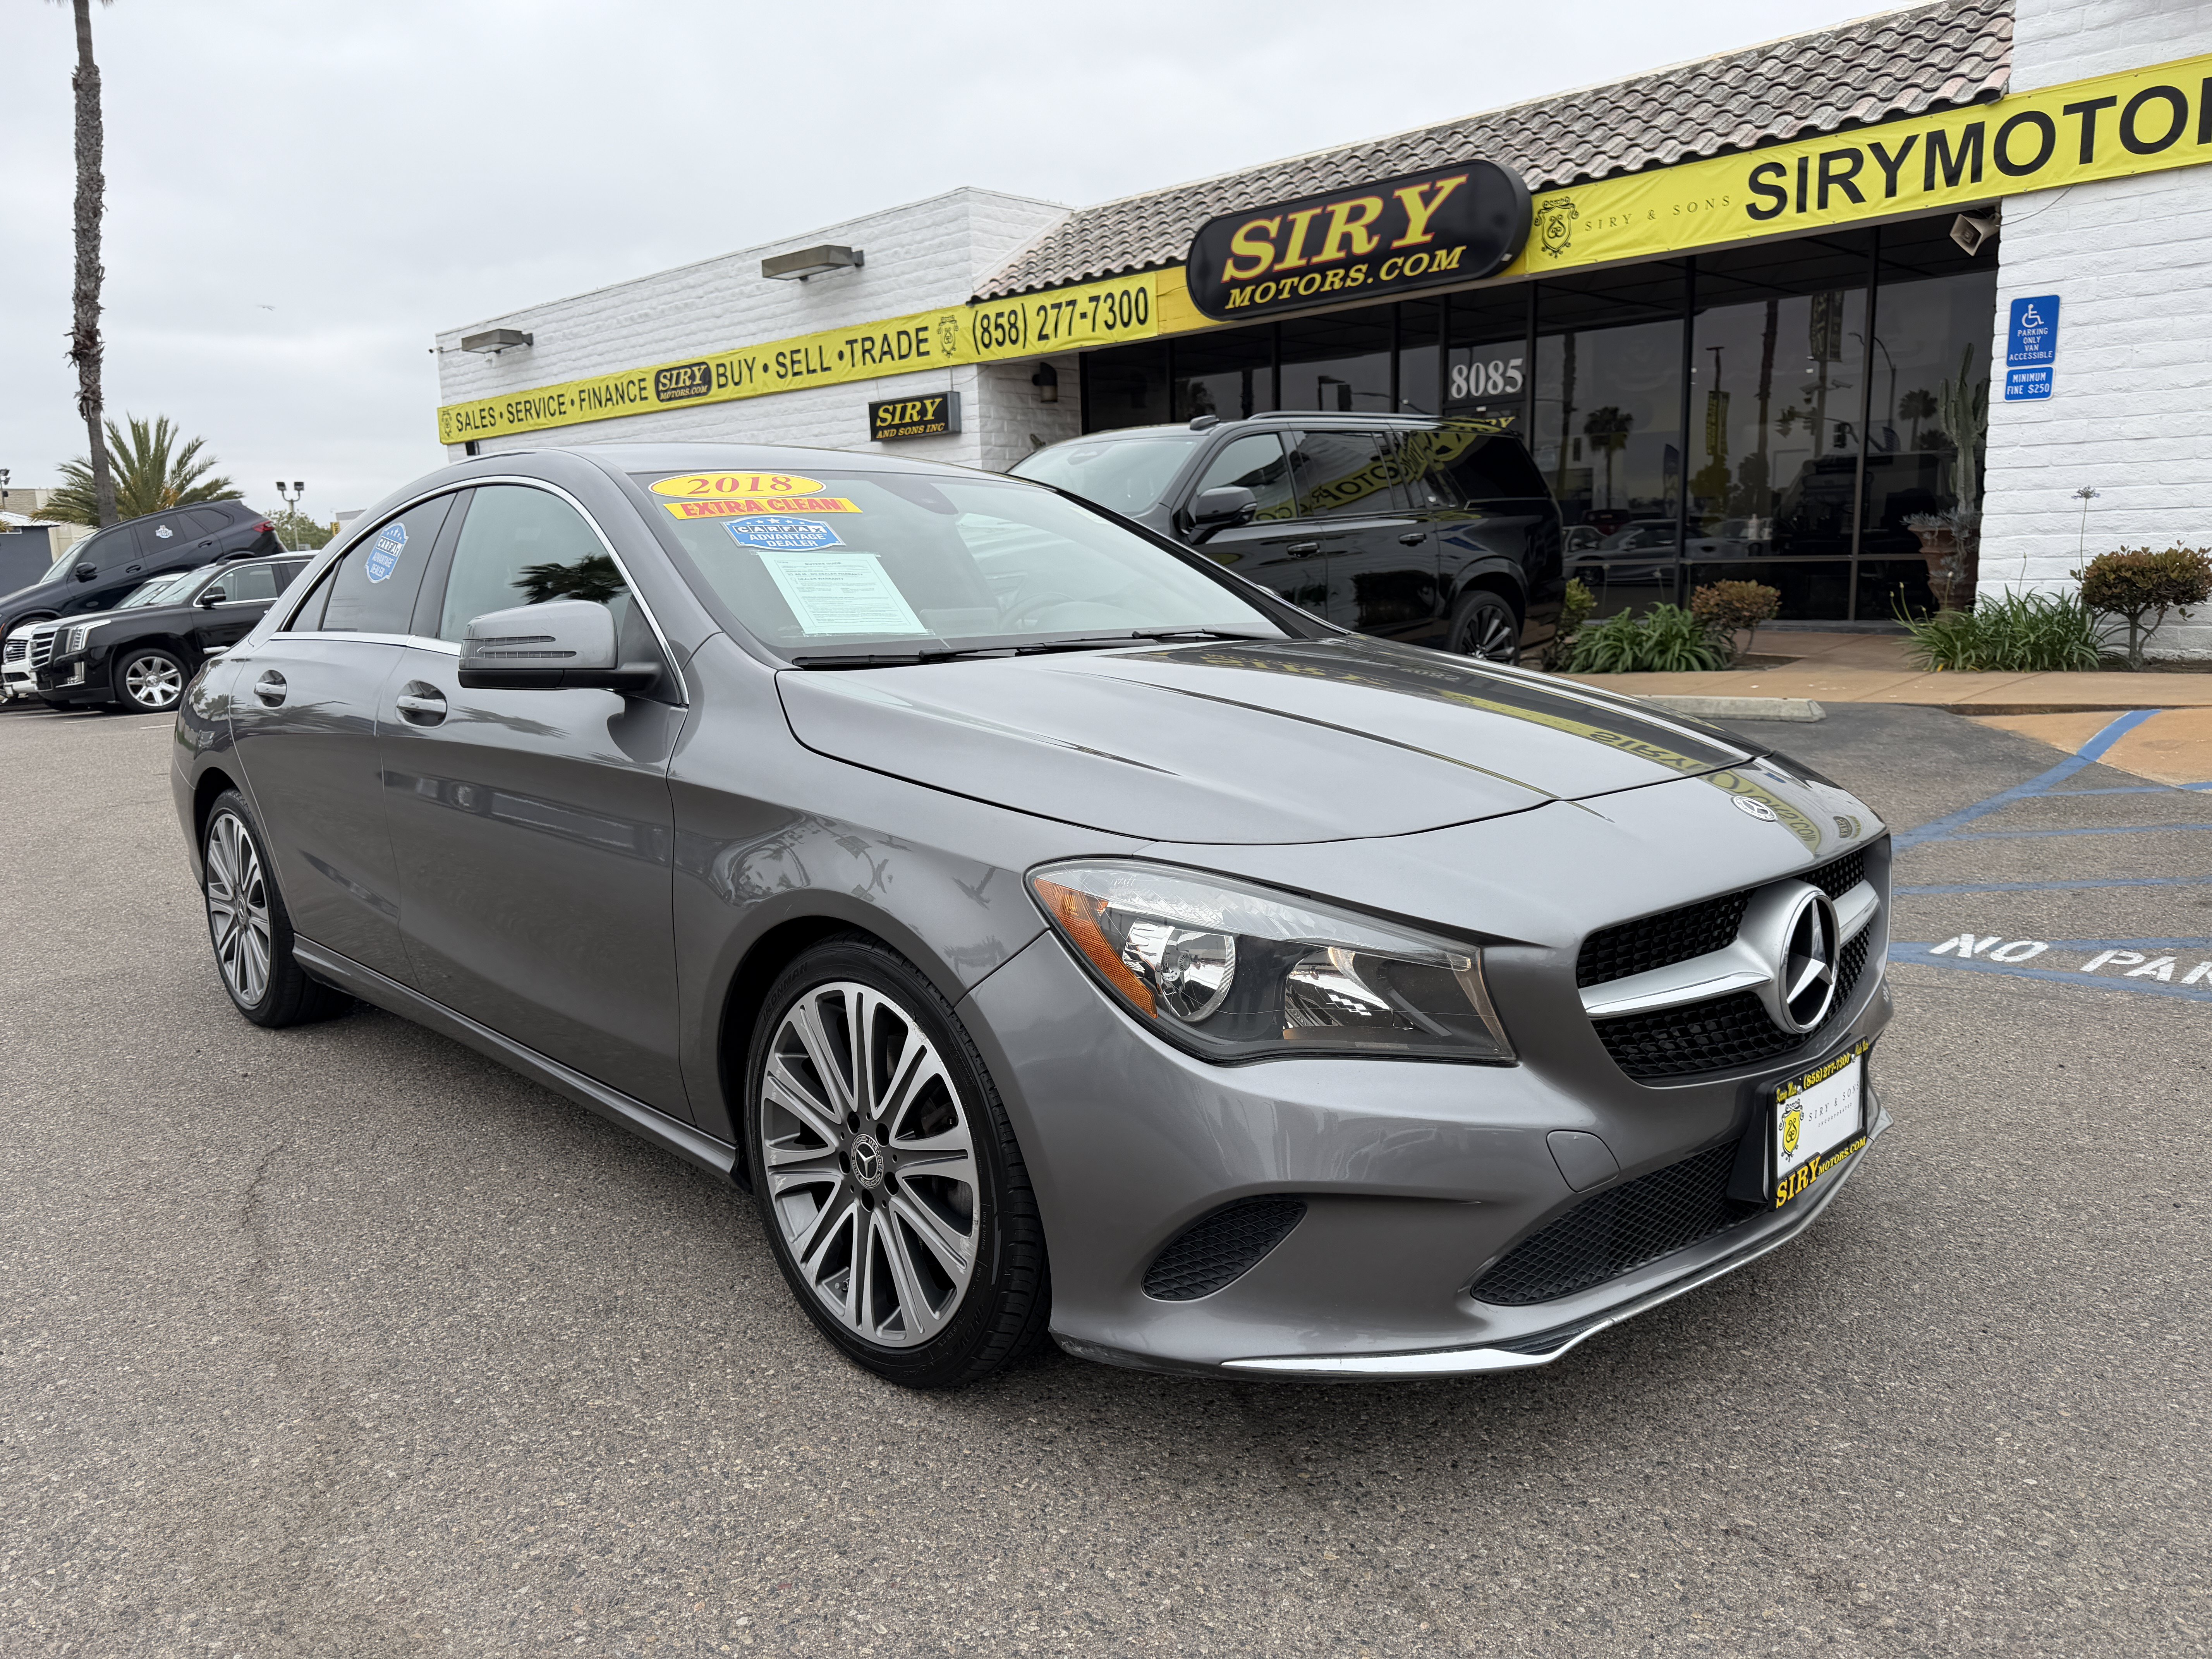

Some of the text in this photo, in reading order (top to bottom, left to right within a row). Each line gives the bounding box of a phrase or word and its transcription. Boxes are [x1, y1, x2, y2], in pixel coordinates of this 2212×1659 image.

[1585, 195, 1730, 232] SIRY & SONS
[1221, 174, 1469, 283] SIRY
[1224, 245, 1467, 310] MOTORS.COM
[972, 287, 1148, 355] (858) 277-7300
[2018, 328, 2048, 337] PARKING
[2023, 336, 2041, 344] ONLY
[717, 326, 931, 389] BUY SELL TRADE
[2009, 351, 2053, 361] ACCESSIBLE
[659, 365, 708, 391] SIRY
[1451, 358, 1524, 399] 8085
[2013, 372, 2046, 383] MINIMUM
[660, 385, 708, 400] MOTORS.COM
[2007, 383, 2050, 395] FINE $250
[456, 377, 649, 432] SALES SERVICE FINANCE
[876, 397, 943, 427] SIRY
[876, 422, 945, 439] AND SONS INC
[687, 476, 793, 495] 2018
[681, 498, 845, 516] EXTRA CLEAN
[735, 525, 826, 533] CARFAX
[378, 538, 402, 557] CARFAX
[1929, 933, 2049, 962] NO
[1803, 1052, 1850, 1090] (858) 277-7300
[1808, 1103, 1829, 1121] SIRY
[1776, 1136, 1867, 1209] SIRY MOTORS.COM
